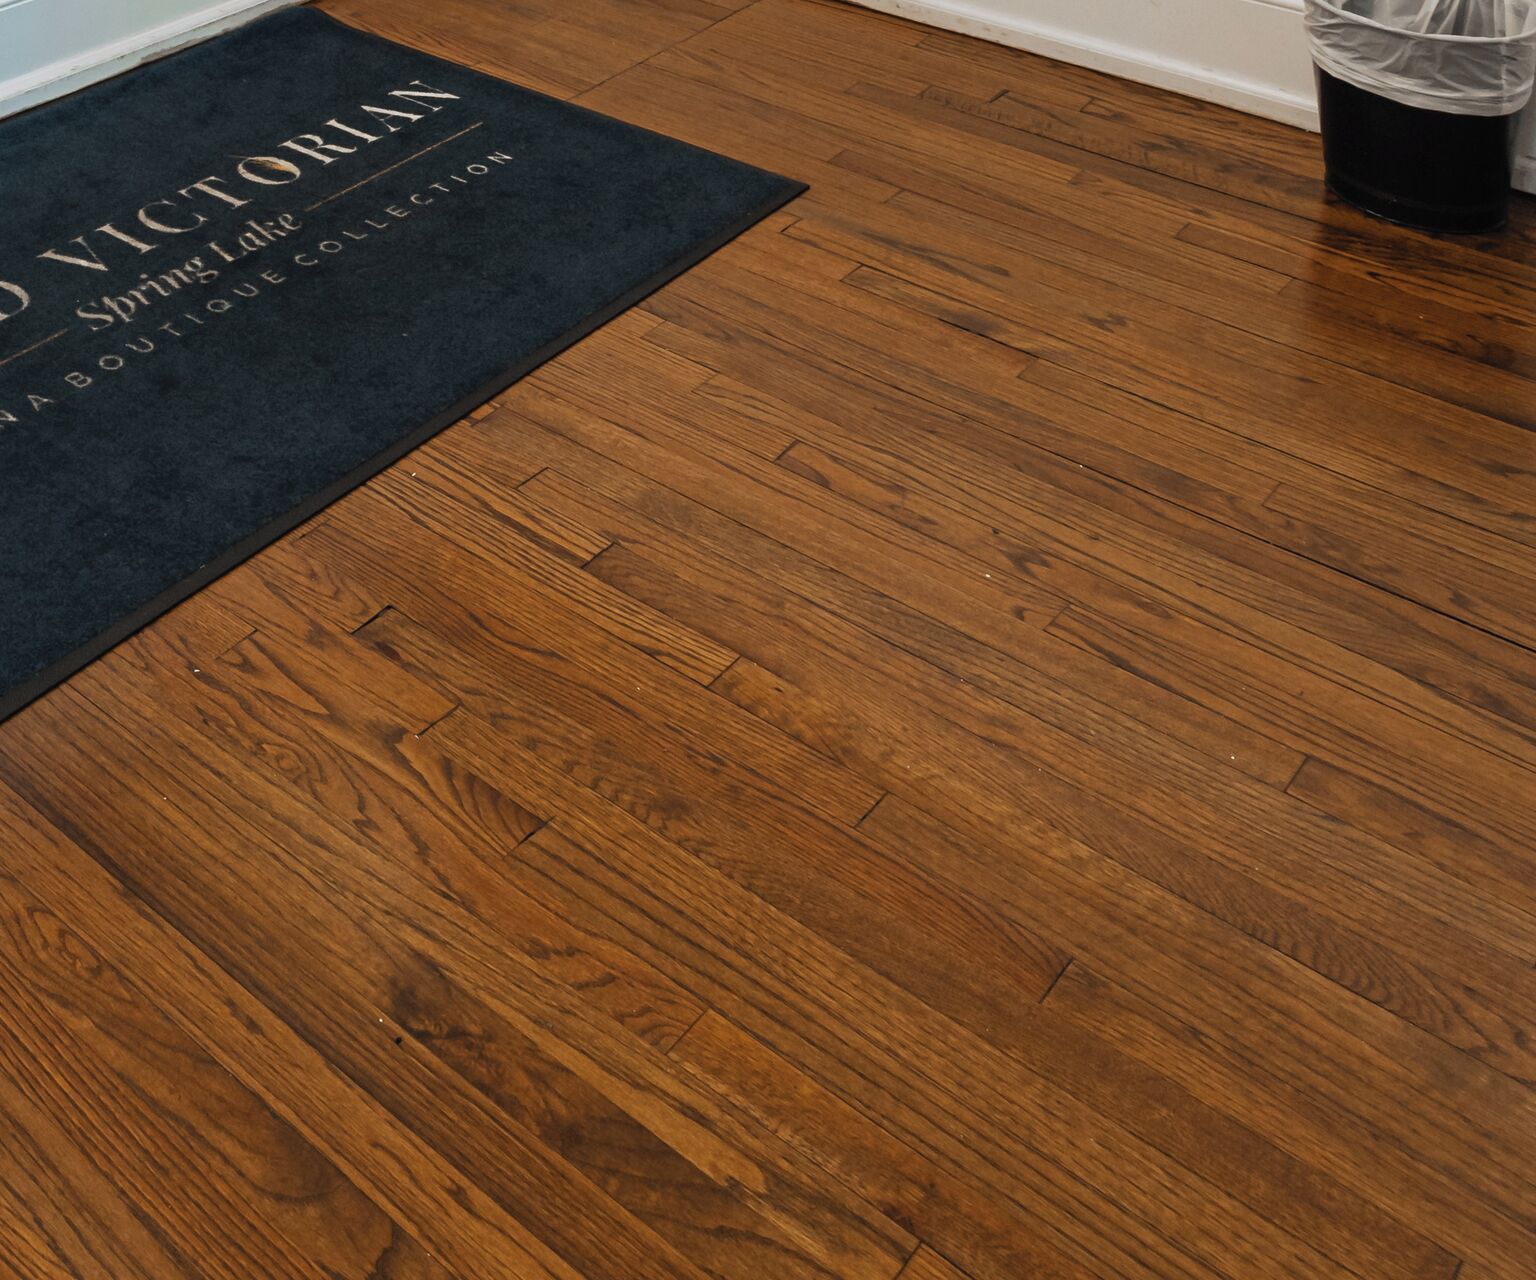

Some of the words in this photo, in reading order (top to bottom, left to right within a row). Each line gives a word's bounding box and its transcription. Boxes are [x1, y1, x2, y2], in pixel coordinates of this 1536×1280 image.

[36, 80, 462, 273] VICTORIAN
[64, 269, 287, 389] BOUTIQUE
[294, 151, 514, 267] COLLECTION
[75, 255, 220, 332] Spring
[207, 213, 304, 264] Lake
